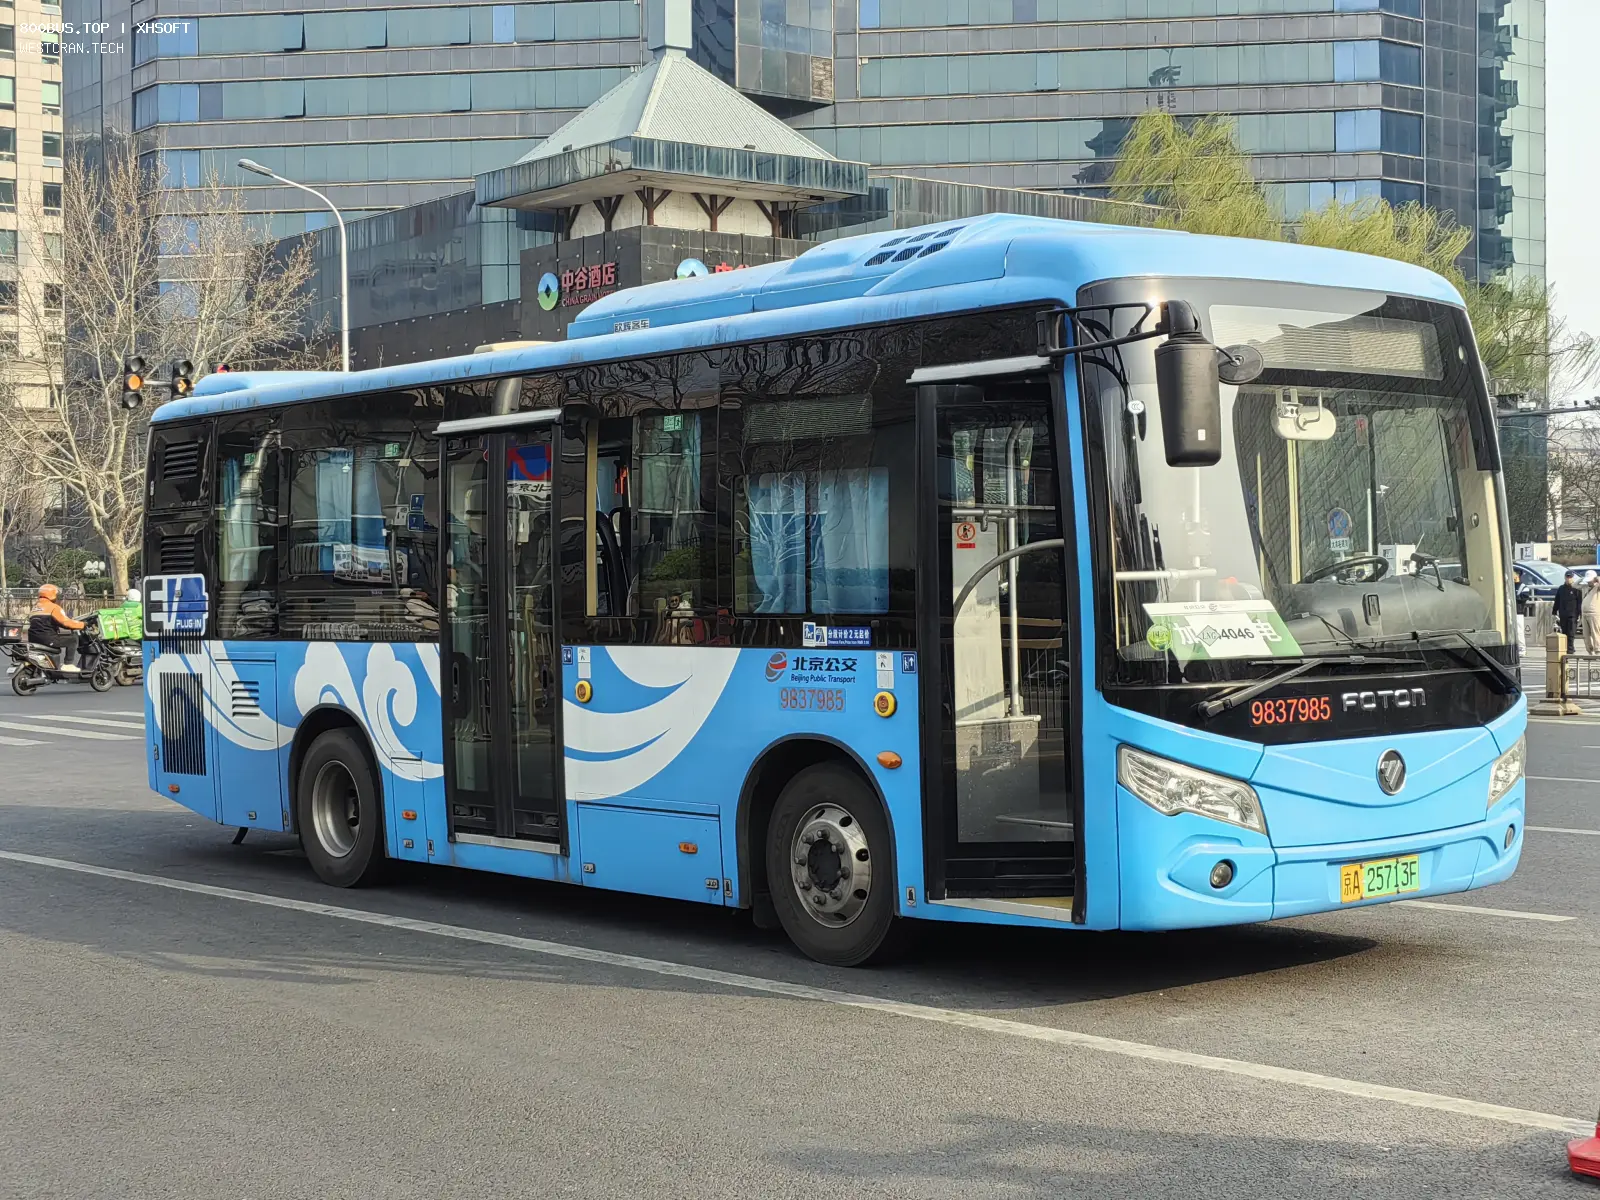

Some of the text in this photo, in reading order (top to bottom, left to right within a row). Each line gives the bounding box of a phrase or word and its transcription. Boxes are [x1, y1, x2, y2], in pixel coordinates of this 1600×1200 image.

[561, 262, 616, 292] 中谷酒店
[561, 296, 579, 307] CHINA
[580, 291, 597, 304] GRAIN
[176, 618, 202, 629] PLUG-IN
[1202, 631, 1217, 640] LNG
[791, 656, 858, 672] 北京公交
[791, 673, 856, 684] Beijing Public Transport
[780, 687, 845, 711] 9837985
[1341, 687, 1427, 712] FOTON
[1251, 696, 1331, 725] 9837985
